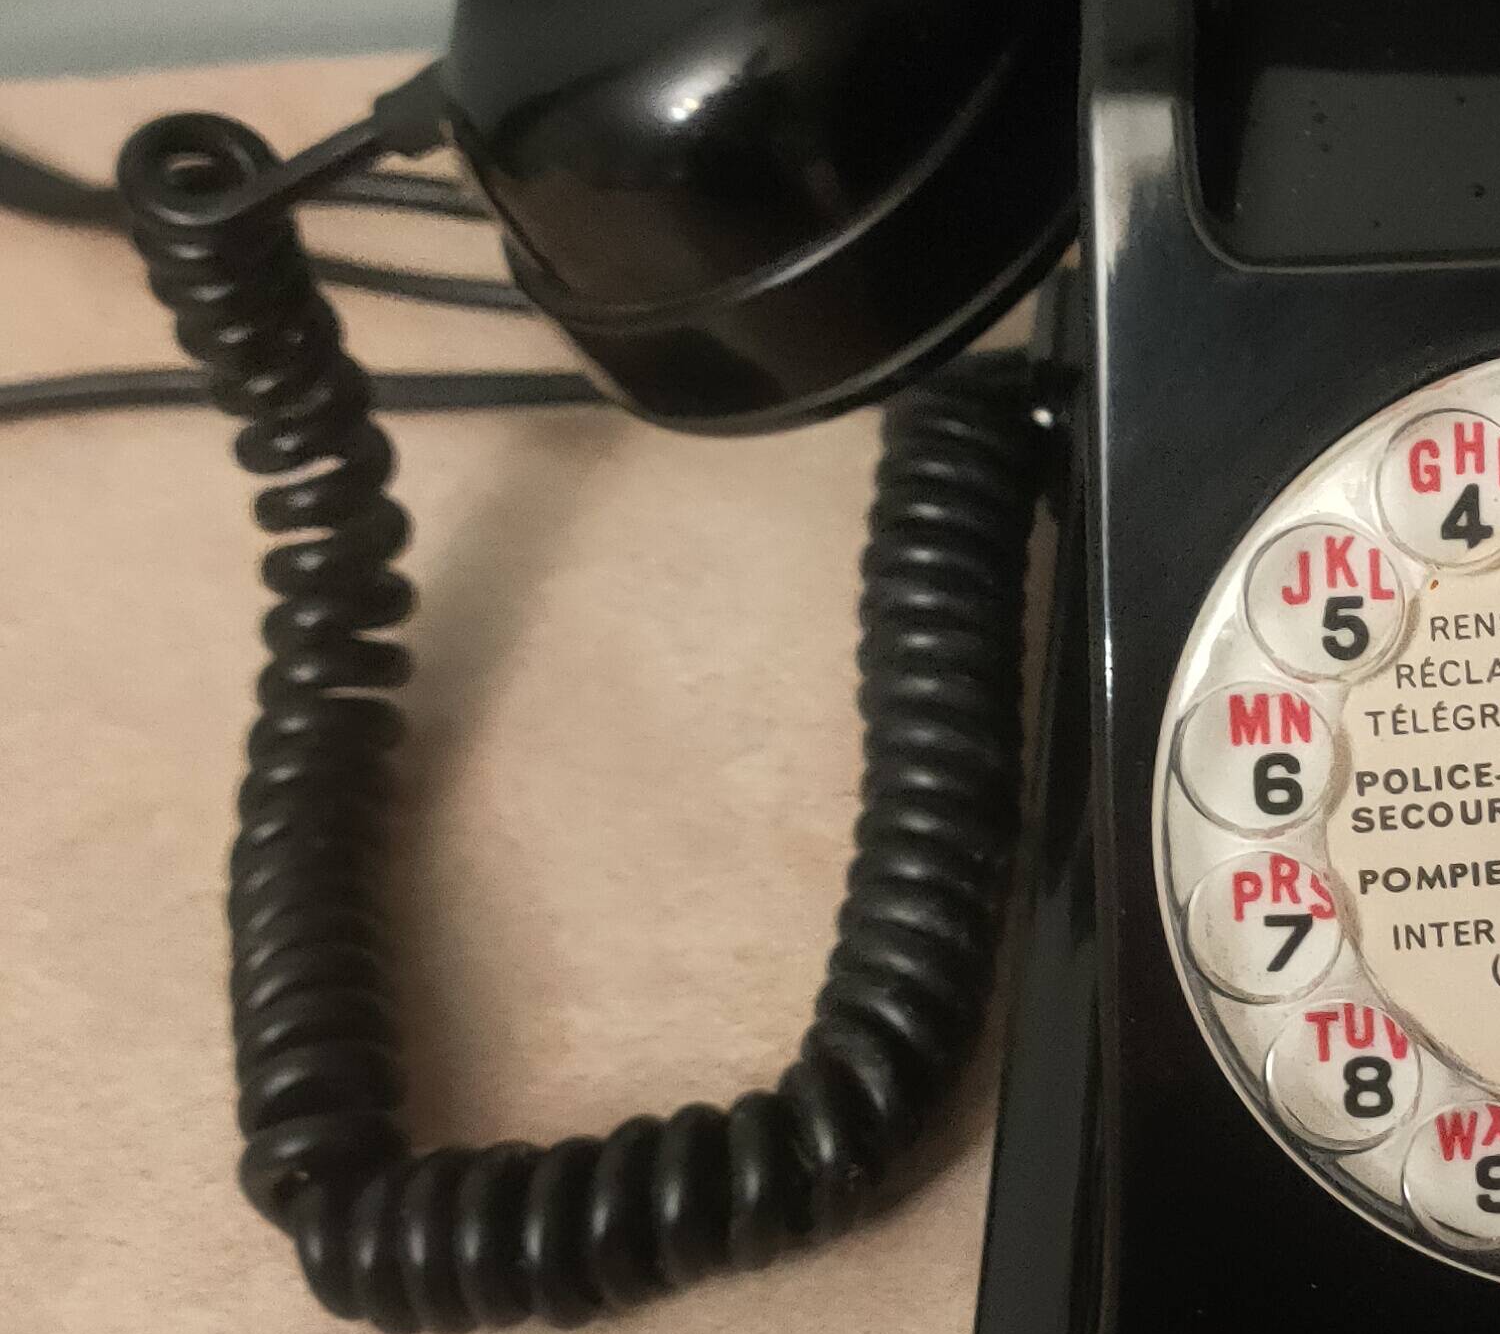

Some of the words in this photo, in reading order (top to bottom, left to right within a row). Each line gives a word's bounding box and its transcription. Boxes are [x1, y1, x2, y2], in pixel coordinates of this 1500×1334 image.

[1441, 483, 1493, 549] 4
[1282, 535, 1395, 606] JKL
[1322, 596, 1371, 661] 5
[1229, 694, 1312, 746] MN
[1253, 752, 1303, 816] 6
[1233, 853, 1337, 923] PRS
[1264, 913, 1313, 972] 7
[1393, 918, 1496, 950] INTER
[1343, 1055, 1394, 1118] 8
